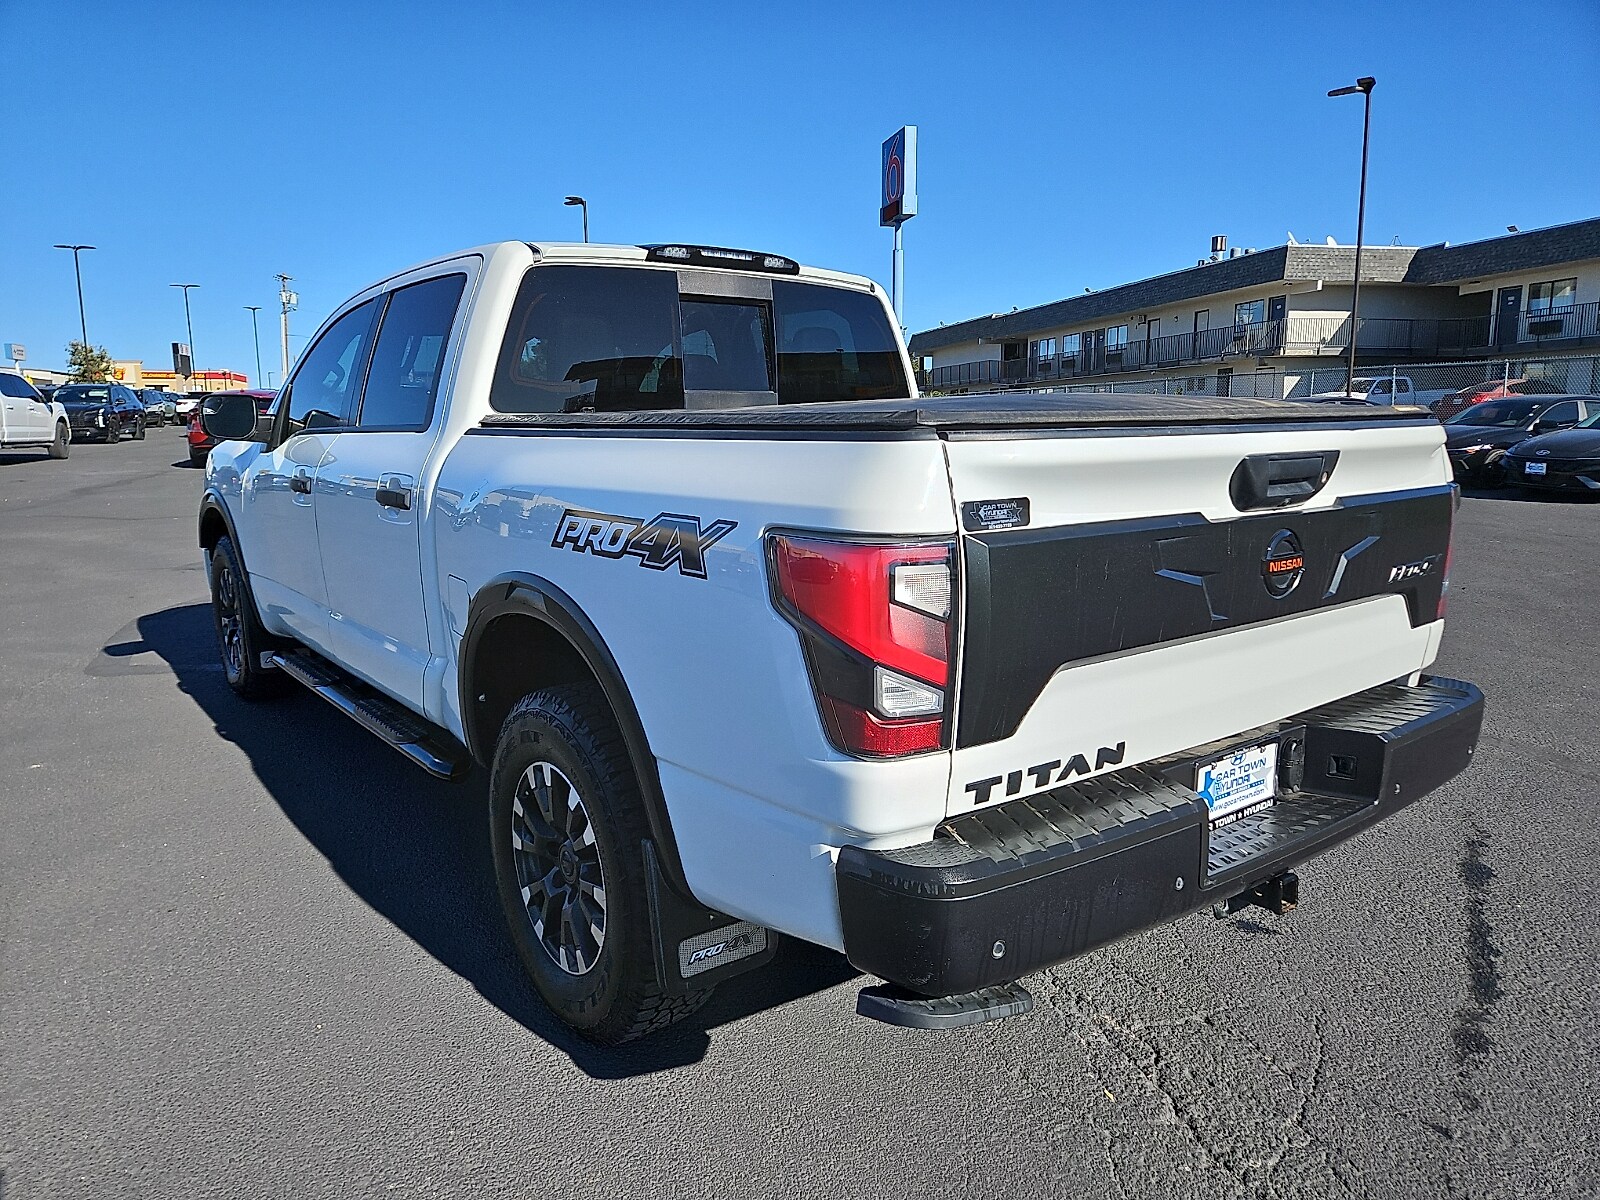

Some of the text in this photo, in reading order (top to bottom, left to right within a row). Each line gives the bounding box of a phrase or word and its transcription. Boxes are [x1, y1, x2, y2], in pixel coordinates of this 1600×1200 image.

[885, 134, 902, 204] 6
[1269, 557, 1303, 573] NISSAN
[964, 741, 1126, 805] TITAN
[1216, 757, 1267, 782] CAR TOWN
[1215, 774, 1251, 794] HYUNDAI
[1214, 812, 1237, 829] TOWN
[1244, 799, 1274, 817] HYUNDAI
